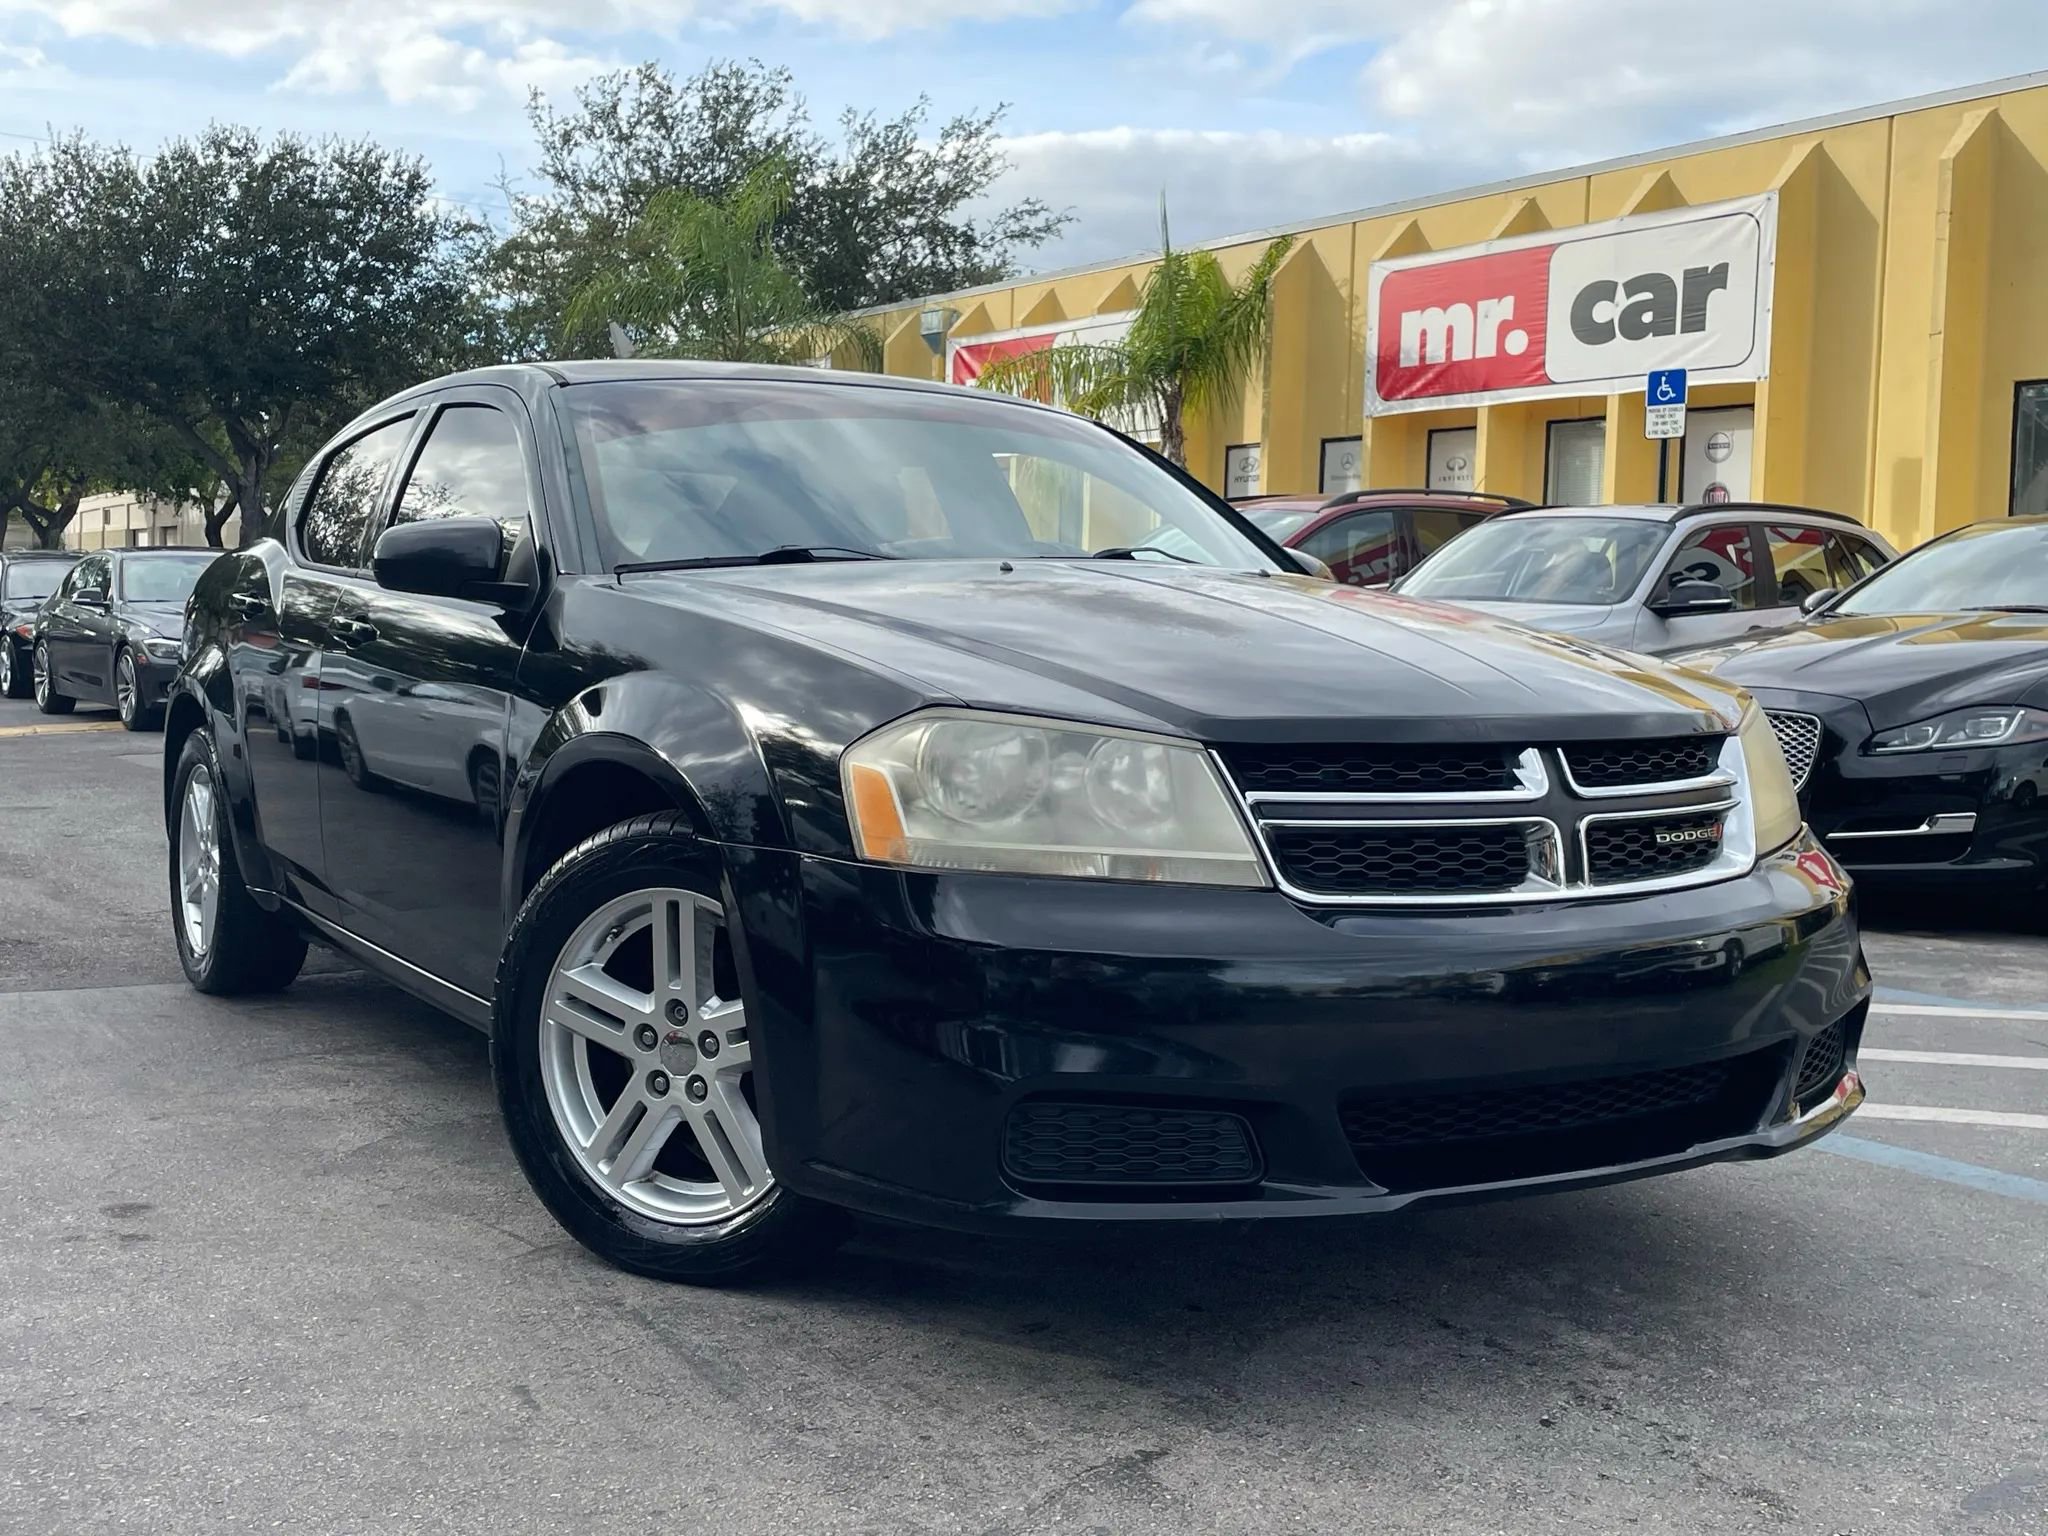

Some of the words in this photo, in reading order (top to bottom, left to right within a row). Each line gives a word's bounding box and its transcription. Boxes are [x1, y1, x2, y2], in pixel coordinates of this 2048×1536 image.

[1400, 295, 1529, 368] mr.
[1570, 262, 1730, 346] car
[1656, 828, 1717, 843] DODGE
